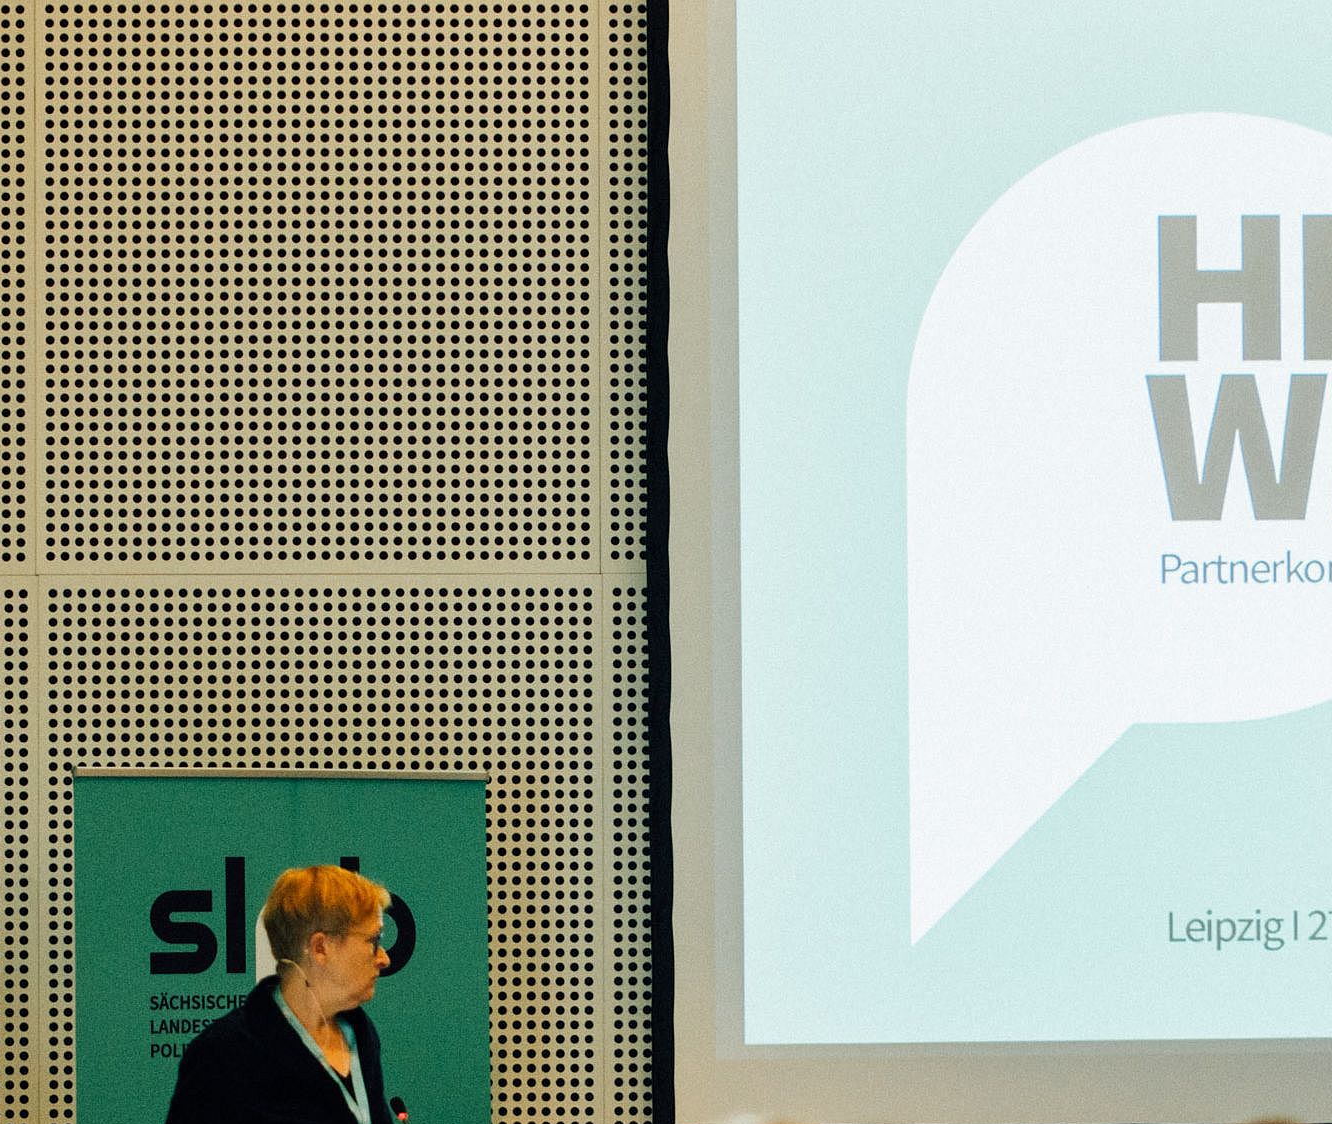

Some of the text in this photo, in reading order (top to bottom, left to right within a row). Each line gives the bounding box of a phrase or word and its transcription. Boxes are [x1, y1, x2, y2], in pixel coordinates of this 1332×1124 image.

[149, 856, 417, 978] slb
[1168, 909, 1285, 951] Leipzig
[149, 1018, 217, 1035] LANDES
[149, 1043, 187, 1058] POLI
